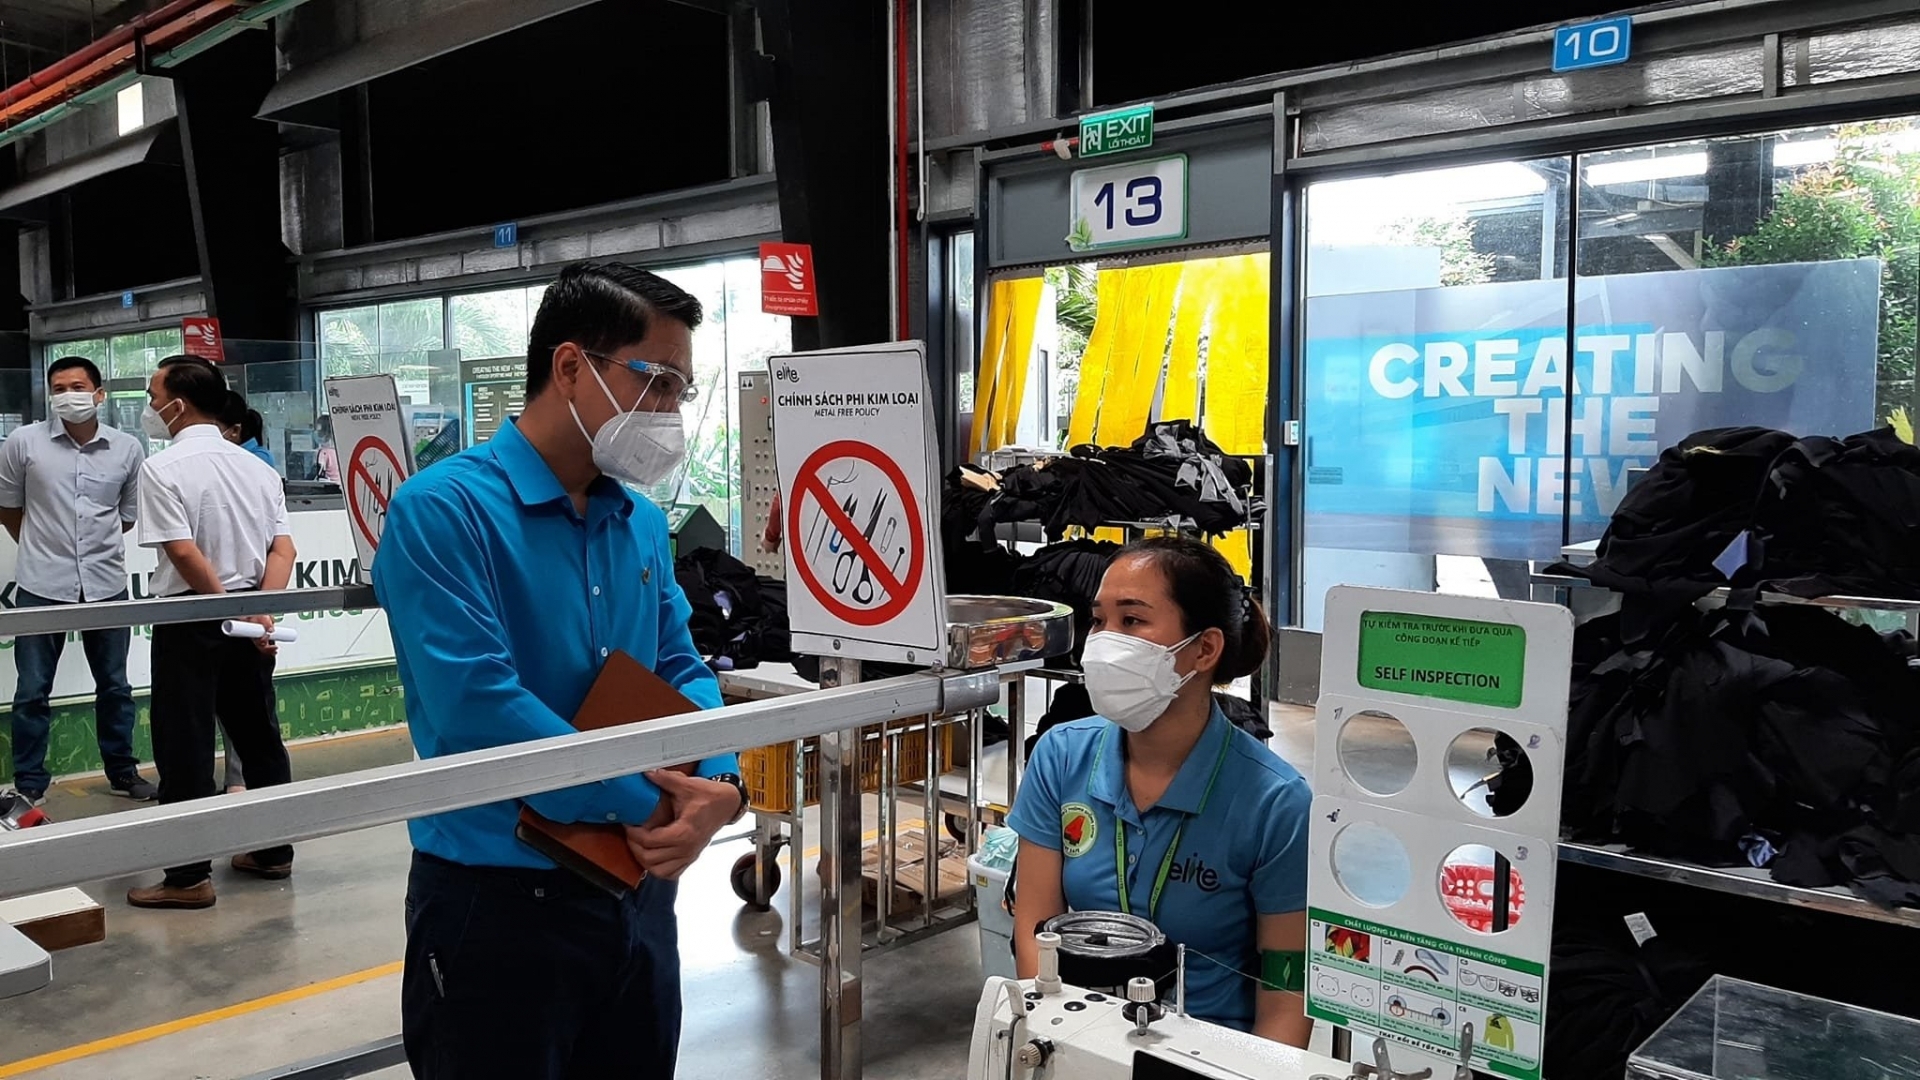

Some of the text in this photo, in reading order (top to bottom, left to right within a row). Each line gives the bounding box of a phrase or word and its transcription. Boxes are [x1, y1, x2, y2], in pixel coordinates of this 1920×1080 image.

[1564, 26, 1619, 60] 10
[1106, 113, 1149, 138] EXIT
[1120, 135, 1146, 148] THOÁT
[1094, 176, 1162, 230] 13
[498, 226, 511, 243] 11
[776, 362, 800, 383] elite
[1368, 328, 1800, 398] CREATING
[778, 390, 919, 408] CHÍNH SÁCH PHI KIM LOẠI
[814, 407, 880, 417] METAL FREE POLICY
[1494, 396, 1660, 456] THE
[295, 558, 359, 588] KIM
[1395, 632, 1420, 643] CÔNG
[1402, 621, 1420, 631] TRA
[1452, 624, 1467, 634] KHI
[1492, 627, 1513, 637] QUA
[1374, 666, 1500, 689] SELF INSPECTION
[1515, 846, 1529, 861] 3
[1168, 852, 1221, 892] elite
